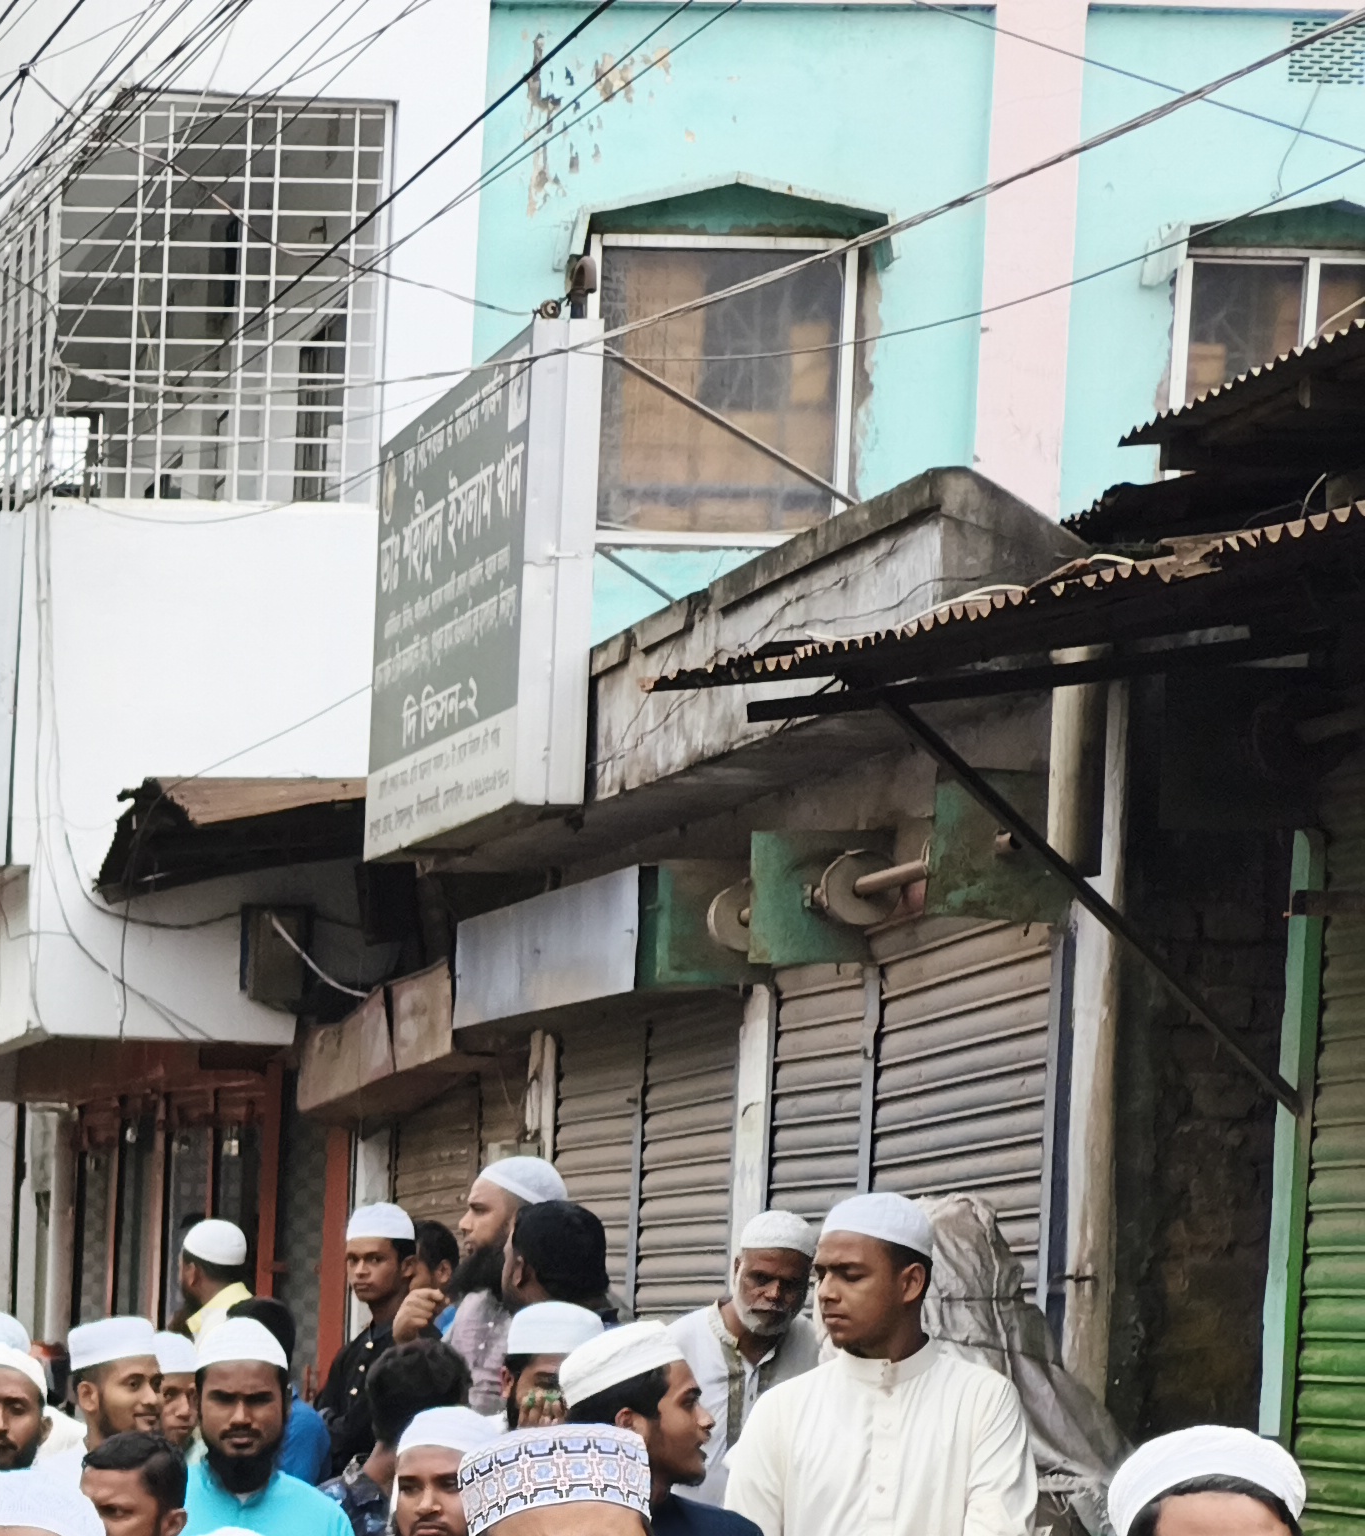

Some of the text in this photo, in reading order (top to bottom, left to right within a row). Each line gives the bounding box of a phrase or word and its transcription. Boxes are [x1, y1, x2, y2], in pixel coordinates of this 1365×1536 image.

[448, 461, 496, 560] ইসলাম
[497, 440, 525, 519] খান
[401, 694, 419, 749] দি
